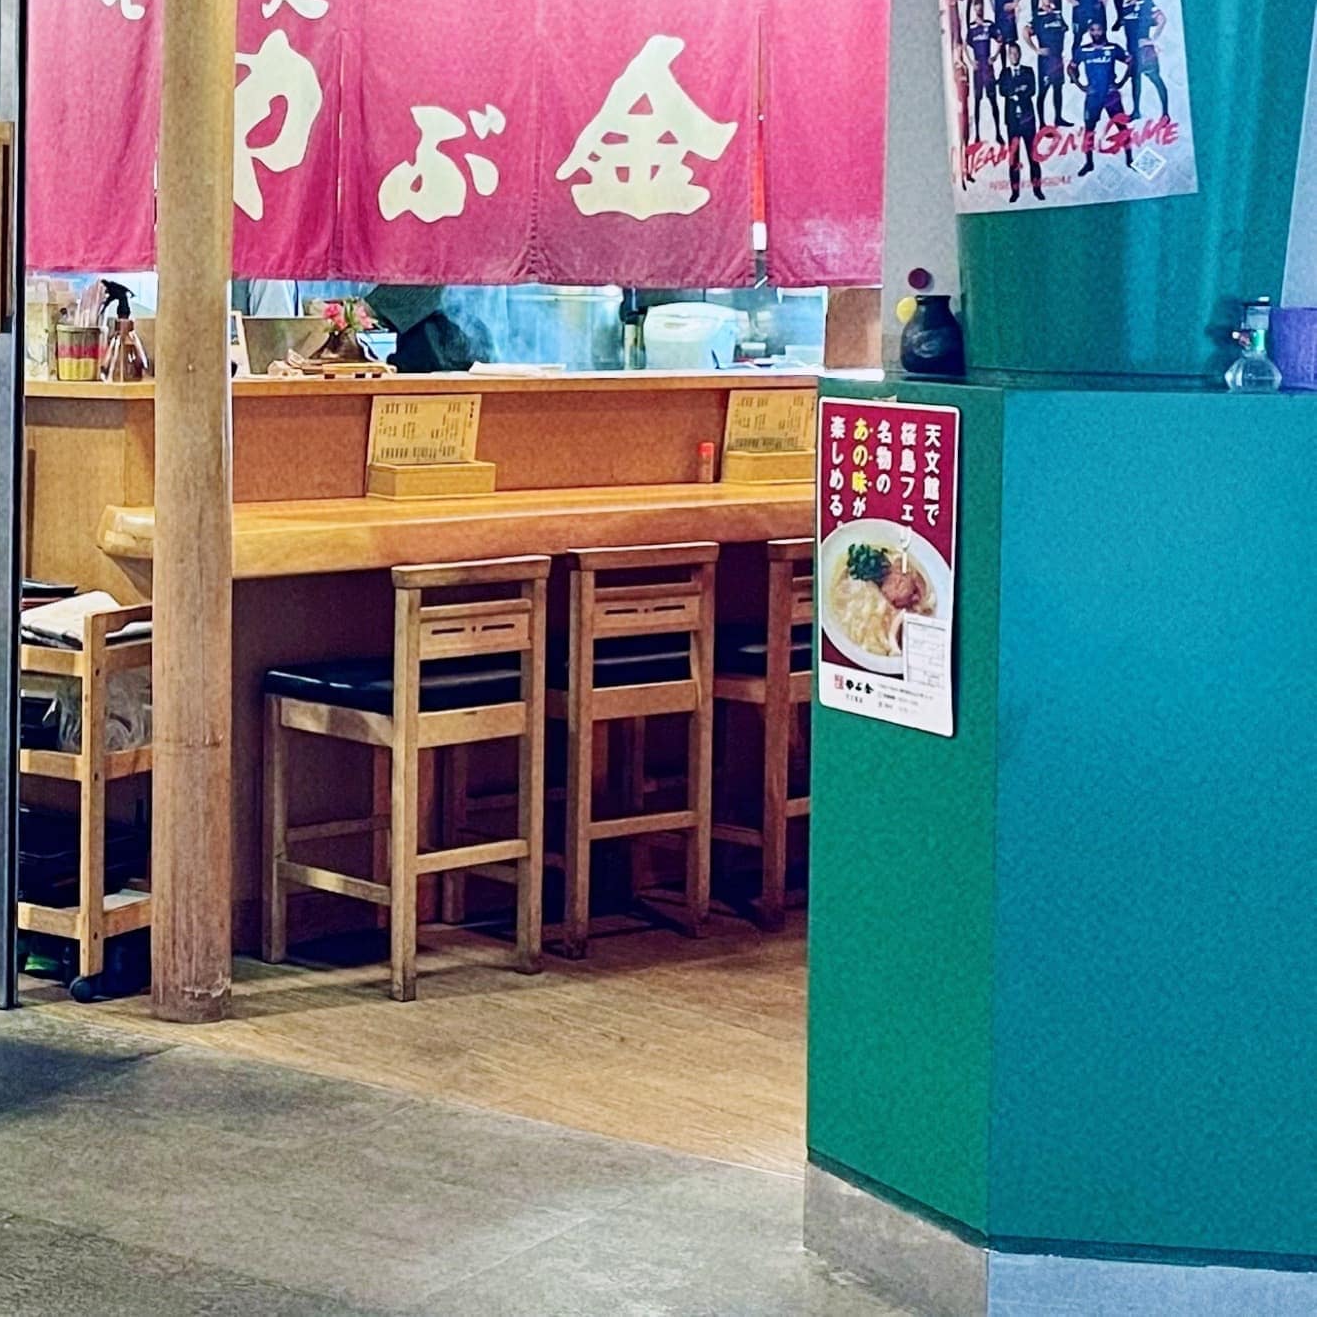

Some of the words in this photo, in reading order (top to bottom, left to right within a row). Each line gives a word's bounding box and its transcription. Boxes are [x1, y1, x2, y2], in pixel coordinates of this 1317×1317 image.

[851, 417, 869, 518] あの味が
[876, 419, 893, 494] 名物の
[899, 422, 917, 574] 桜島フェリー
[923, 423, 942, 526] 天文館で
